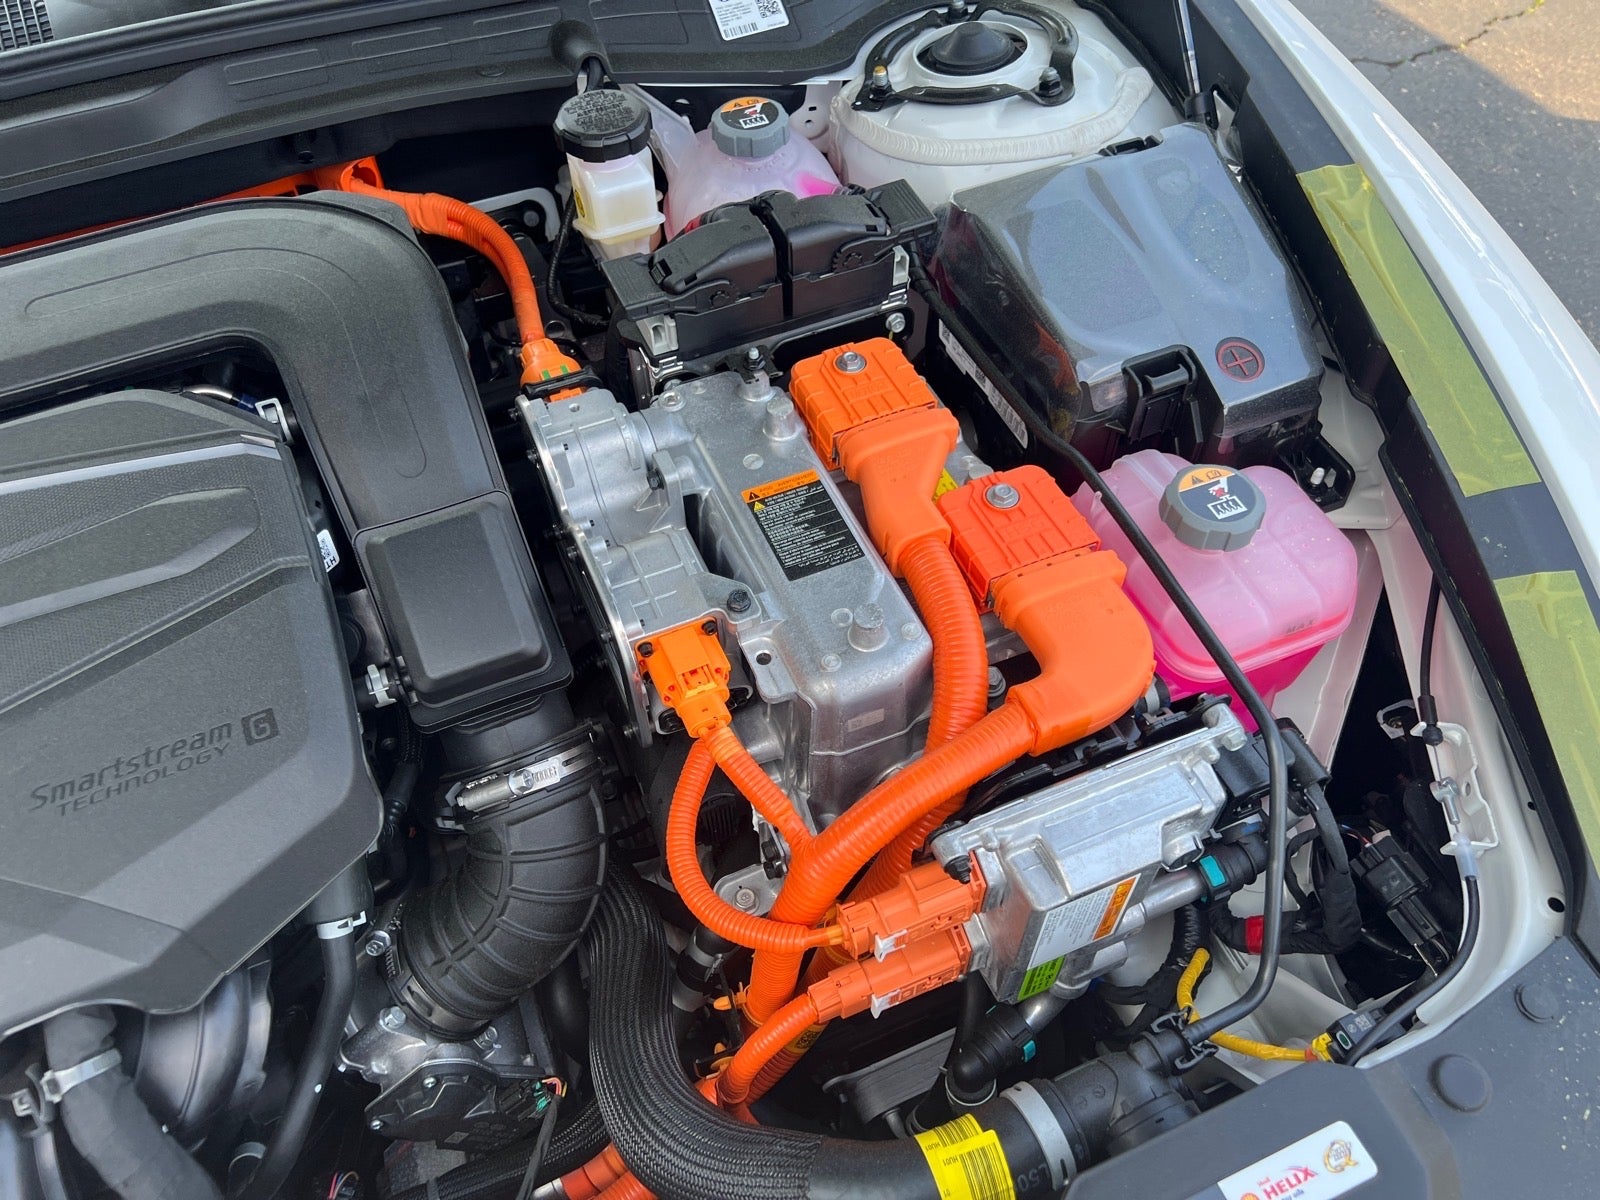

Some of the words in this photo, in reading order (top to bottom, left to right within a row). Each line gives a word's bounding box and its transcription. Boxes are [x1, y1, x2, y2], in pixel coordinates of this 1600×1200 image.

[28, 722, 232, 811] Smartstream
[57, 743, 231, 816] TECHNOLOGY
[1263, 1167, 1316, 1200] HELIX
